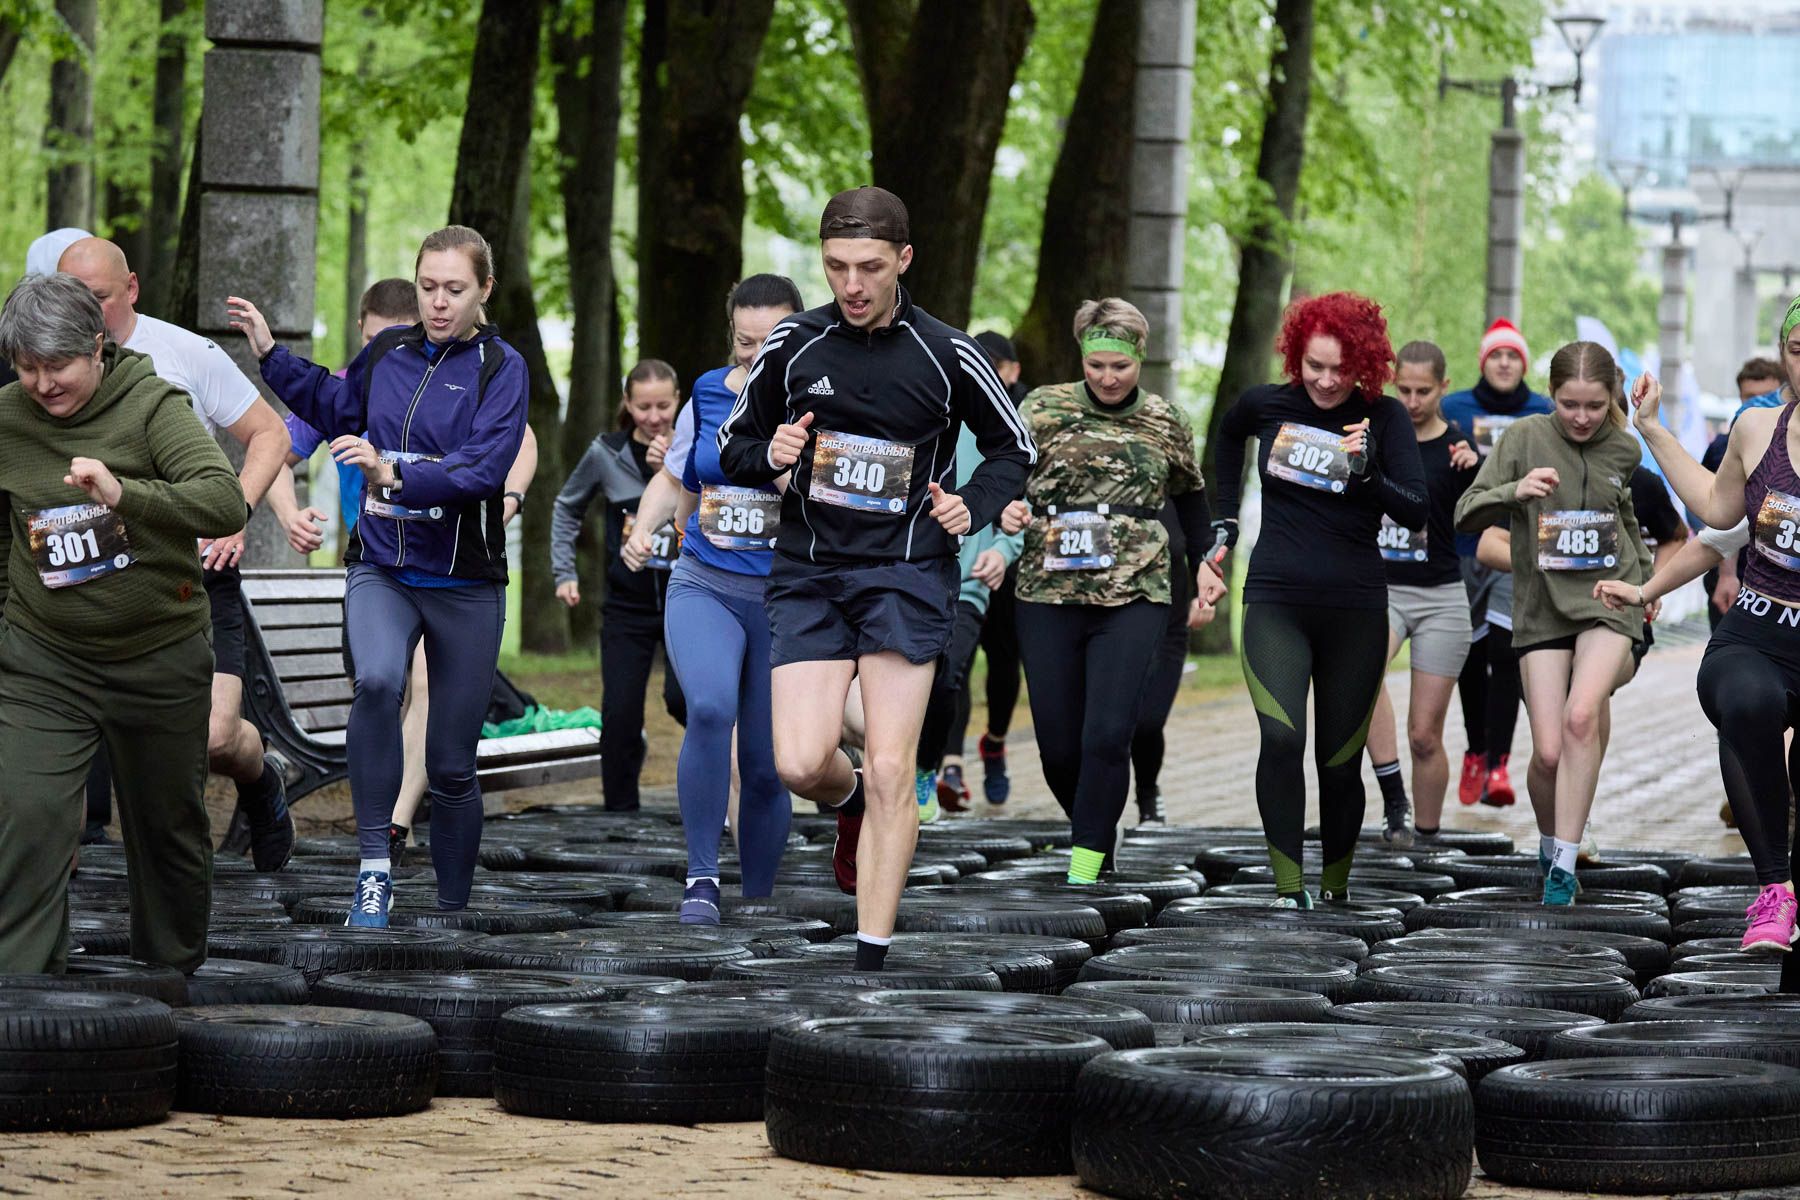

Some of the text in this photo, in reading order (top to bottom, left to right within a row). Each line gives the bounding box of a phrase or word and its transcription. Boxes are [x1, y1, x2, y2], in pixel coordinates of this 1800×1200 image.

[808, 387, 834, 396] adidas
[819, 439, 911, 457] ЗАБЕГ ОТВАЖНЫХ
[1288, 442, 1334, 475] 302
[833, 457, 886, 493] 340
[704, 491, 782, 502] ЗАБЕГ ОТВАЖНЫХ
[1767, 499, 1796, 514] ЗАБЕГ
[717, 505, 765, 534] 336
[47, 528, 100, 567] 301
[1060, 530, 1093, 555] 324
[1557, 529, 1599, 554] 483
